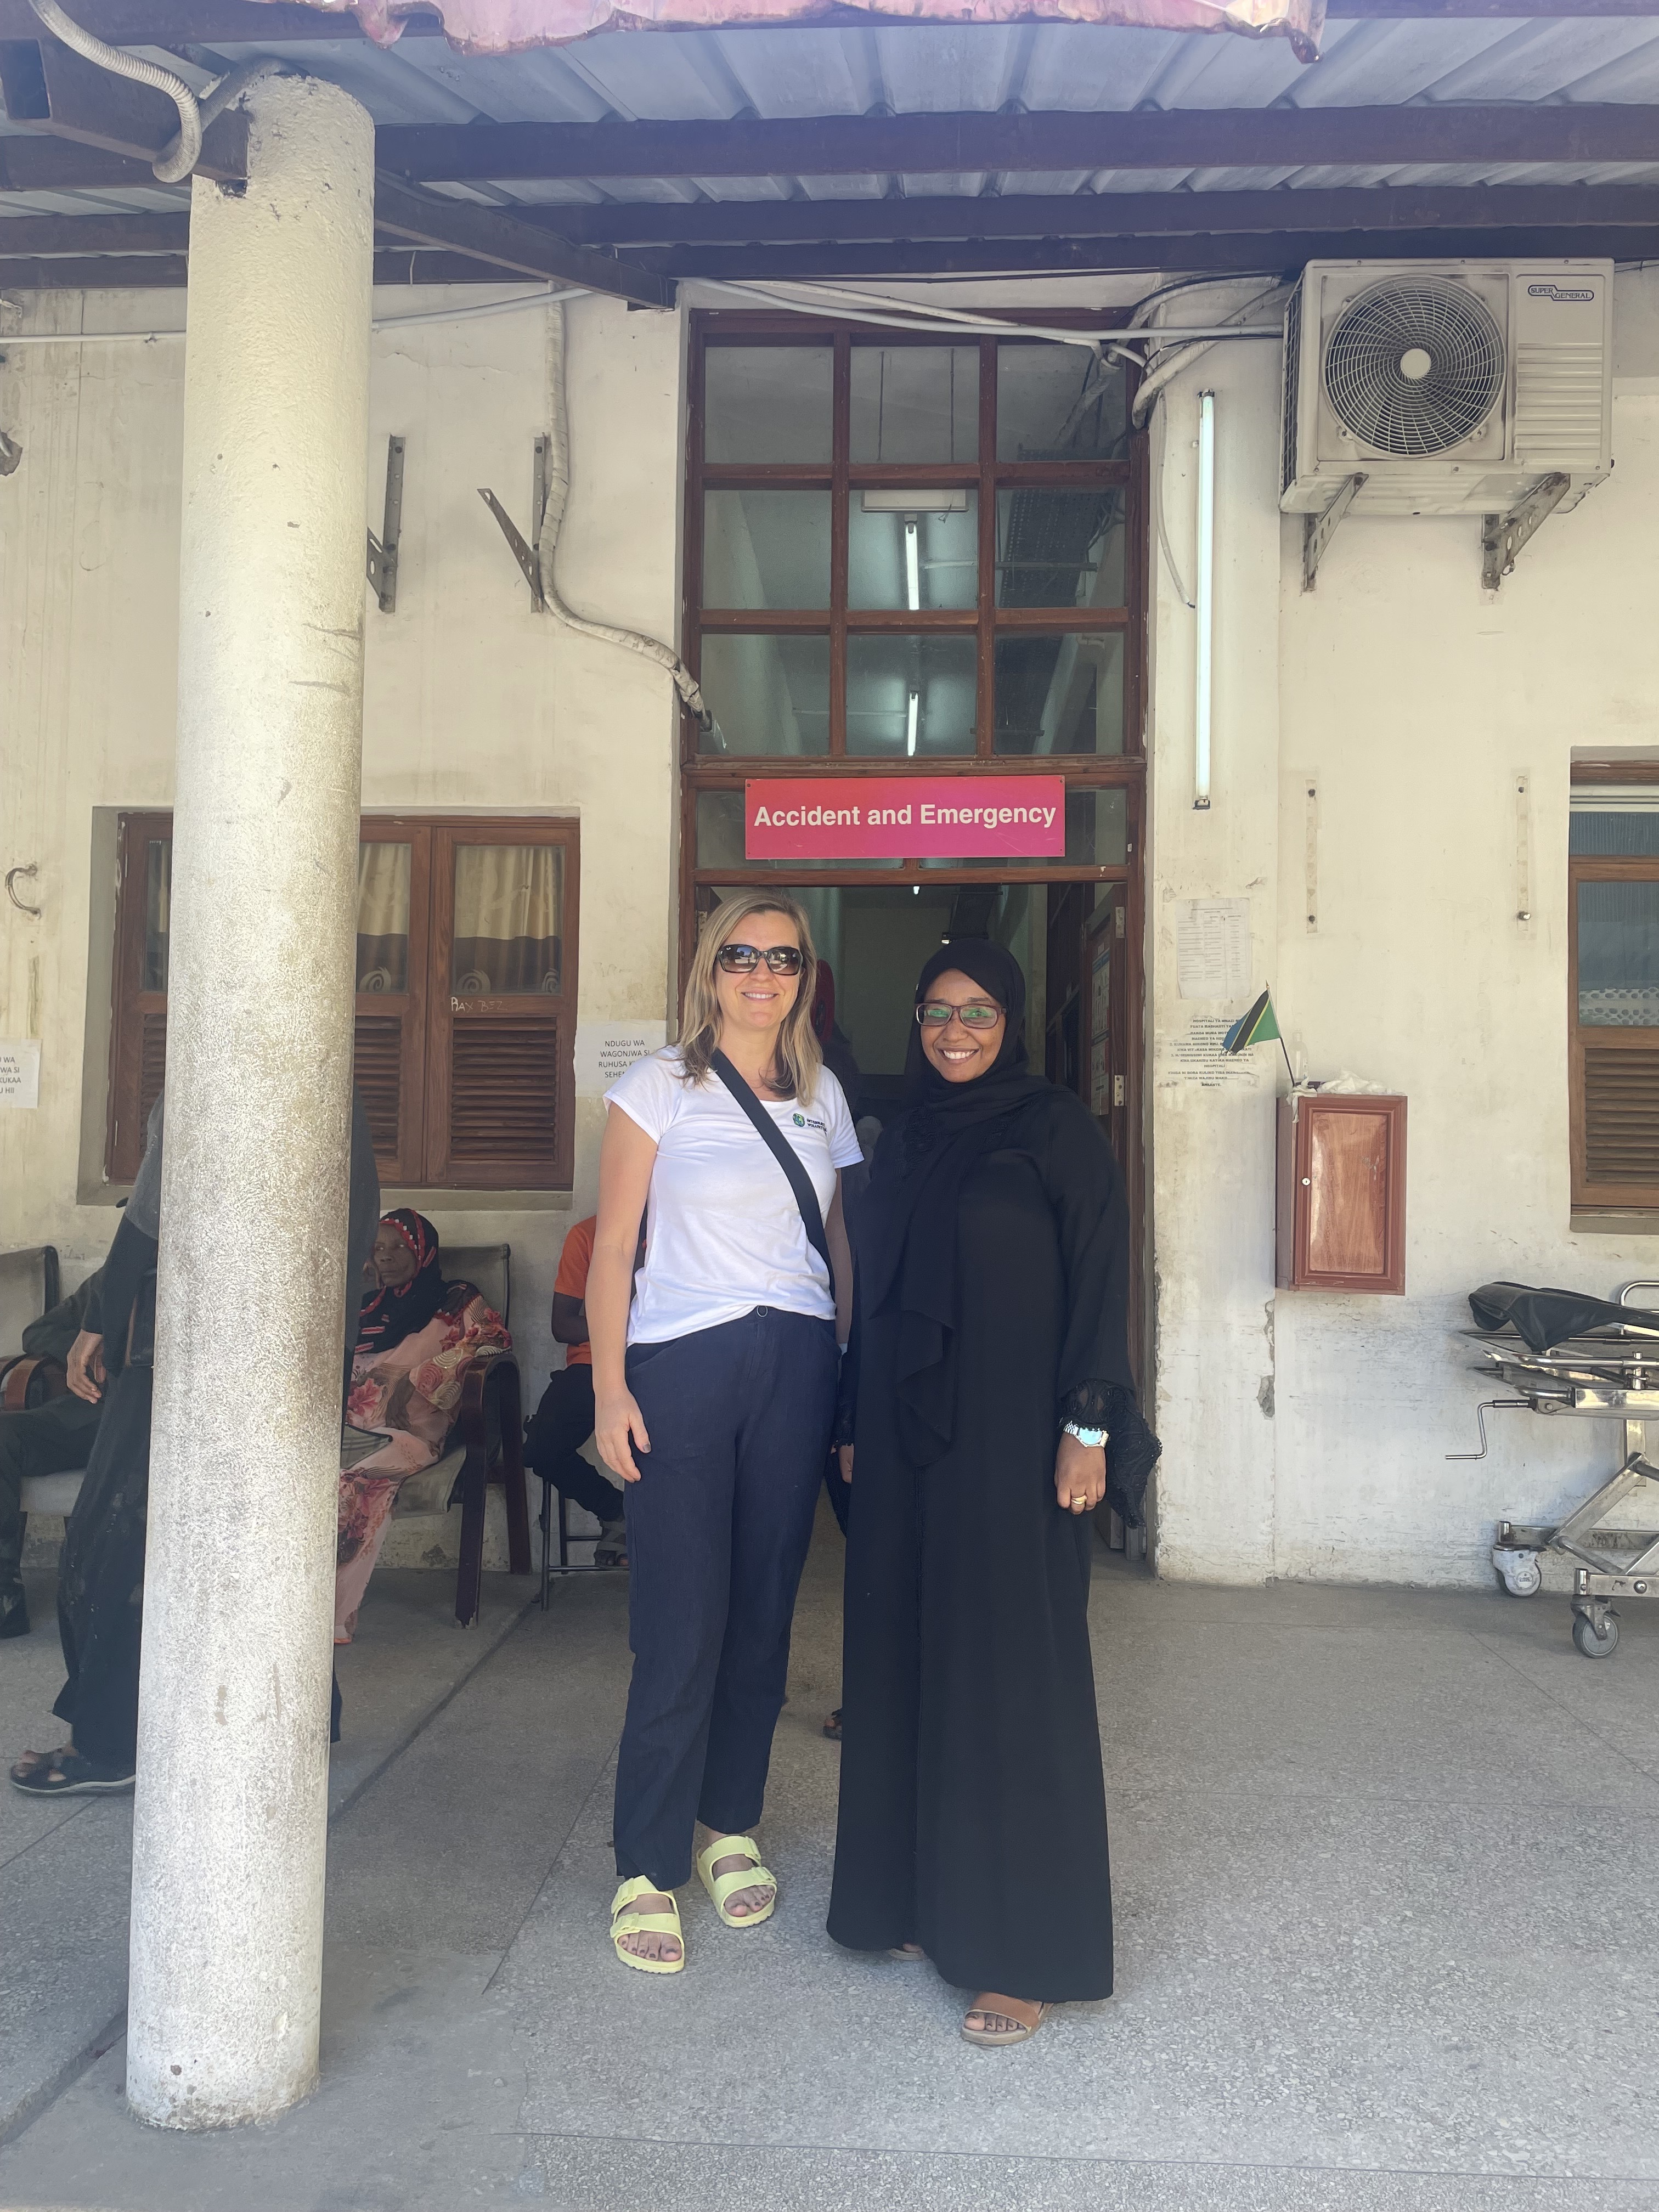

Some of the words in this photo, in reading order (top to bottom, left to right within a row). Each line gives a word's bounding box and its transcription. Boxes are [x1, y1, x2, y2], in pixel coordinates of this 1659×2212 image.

[754, 805, 860, 827] Accident
[867, 804, 912, 825] and
[920, 803, 1057, 829] Emergency
